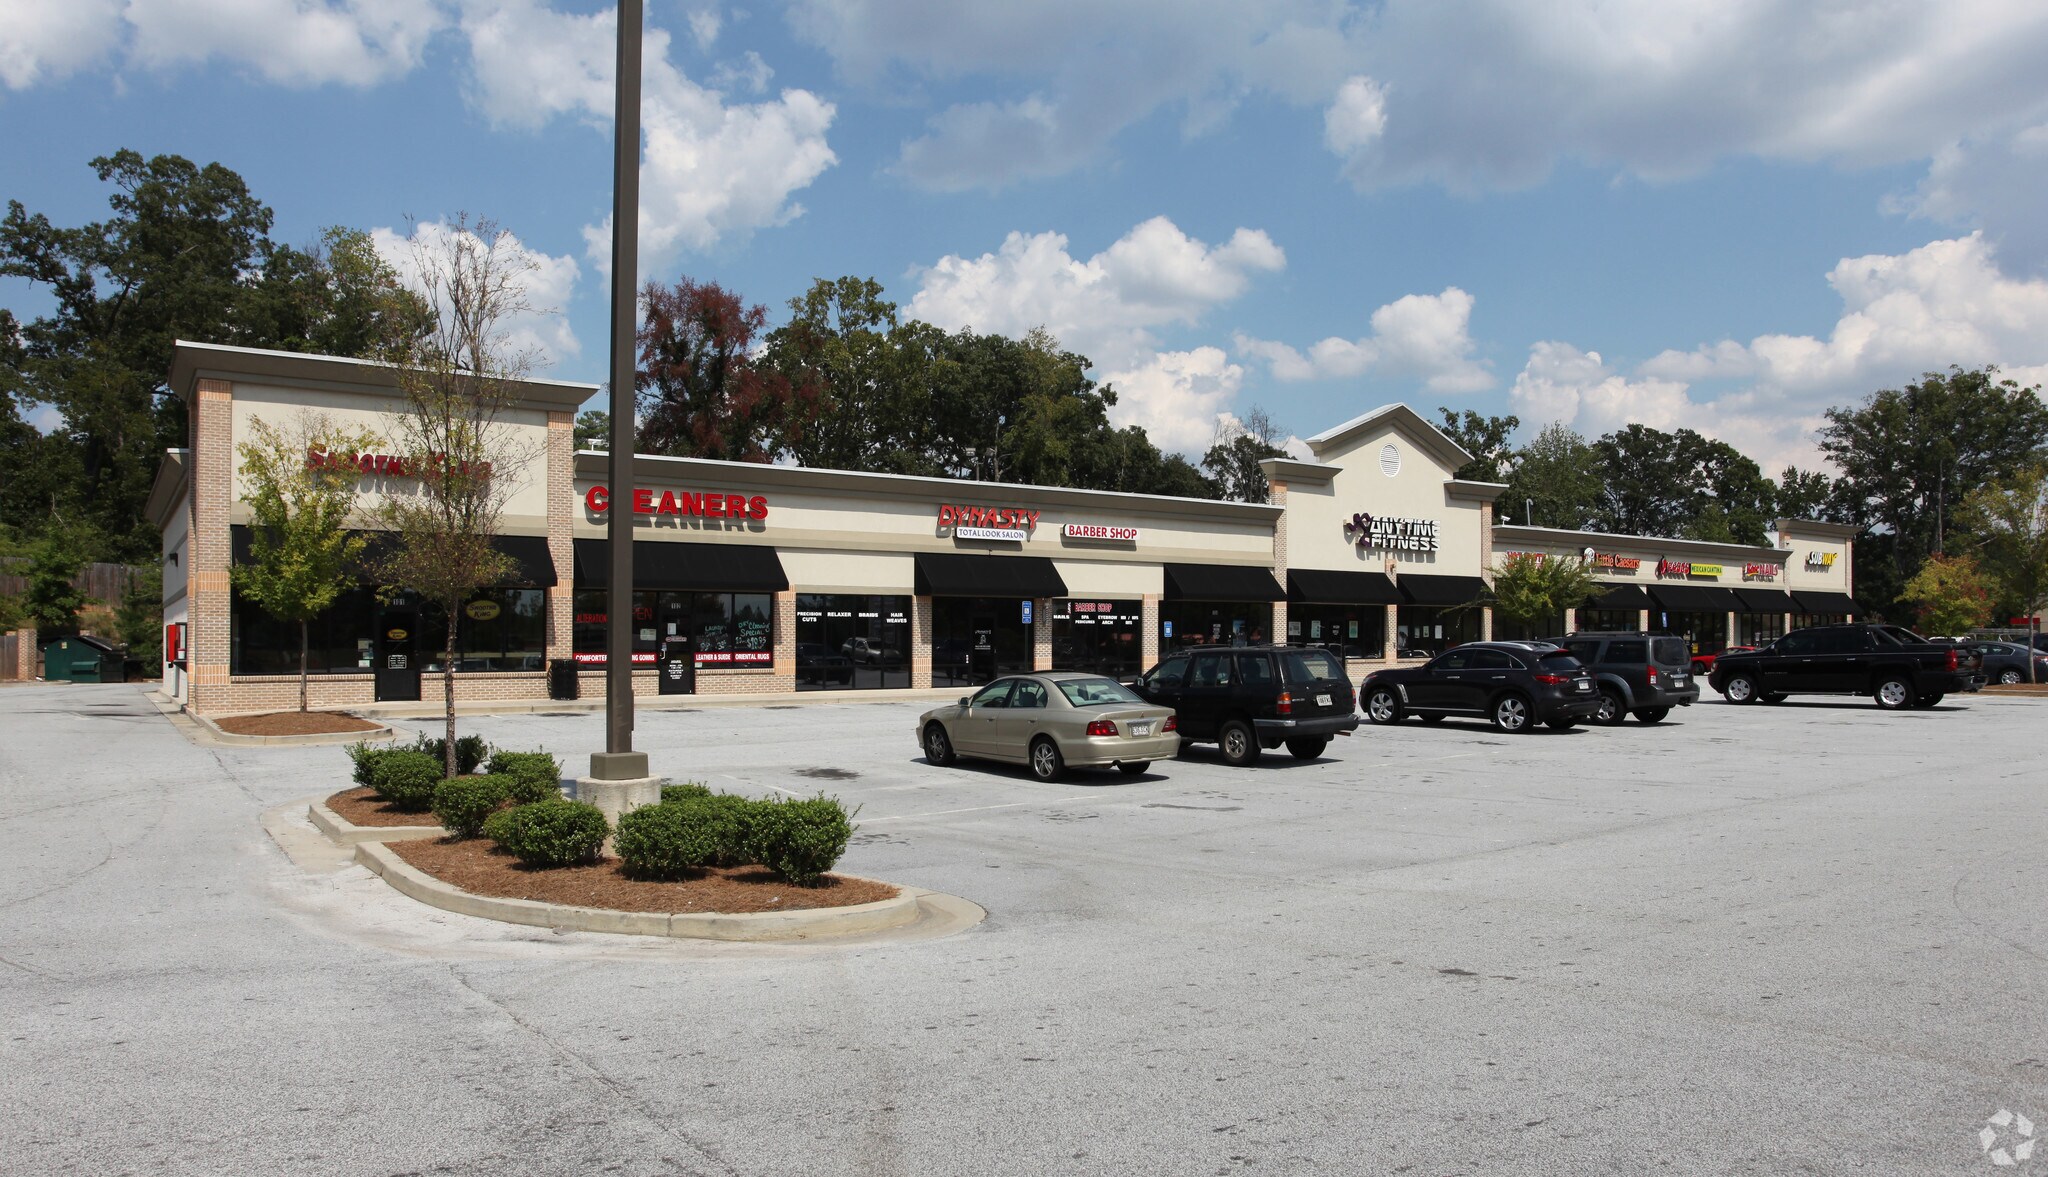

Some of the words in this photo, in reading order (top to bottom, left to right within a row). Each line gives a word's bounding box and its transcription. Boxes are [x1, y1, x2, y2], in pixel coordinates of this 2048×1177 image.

[586, 486, 768, 520] CEANERS
[937, 504, 1040, 530] DYNASTY
[958, 528, 981, 538] TOTAL
[982, 529, 1000, 539] LOOK
[1001, 530, 1024, 539] SALON
[1068, 525, 1107, 539] BARBER
[1110, 527, 1138, 540] SHOP
[1370, 516, 1441, 537] ANYTIME
[1371, 534, 1441, 551] FITNESS
[1809, 551, 1837, 566] SUBWAY
